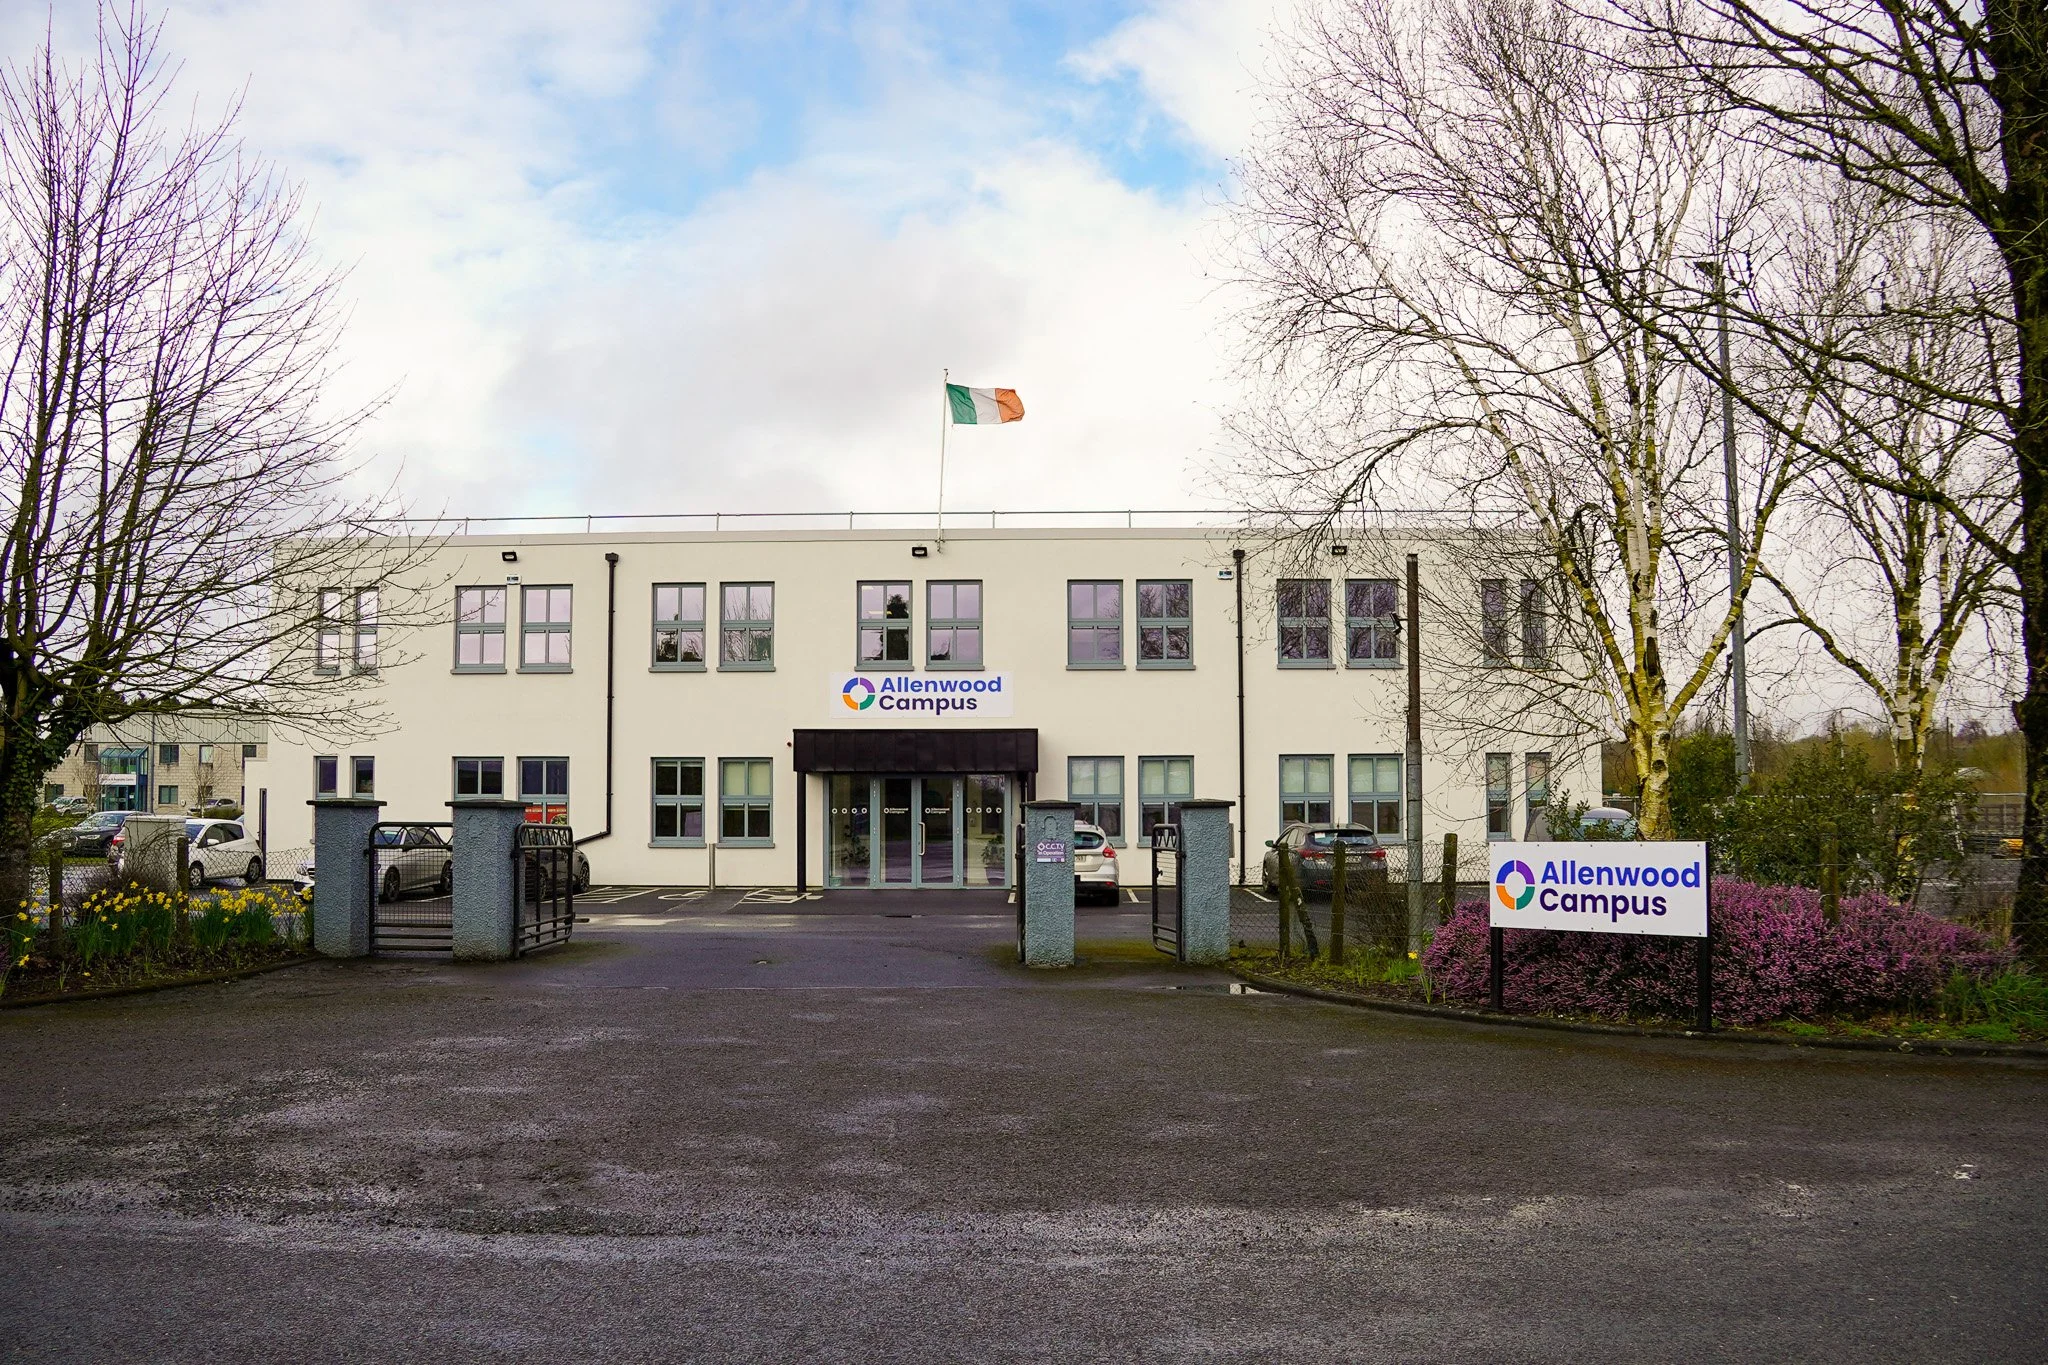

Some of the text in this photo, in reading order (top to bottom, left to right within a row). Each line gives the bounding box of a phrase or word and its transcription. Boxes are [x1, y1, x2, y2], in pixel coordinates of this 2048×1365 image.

[880, 677, 1001, 692] Allenwood
[879, 695, 977, 715] Campus
[1541, 860, 1700, 888] Allenwood
[1539, 888, 1667, 923] Campus
